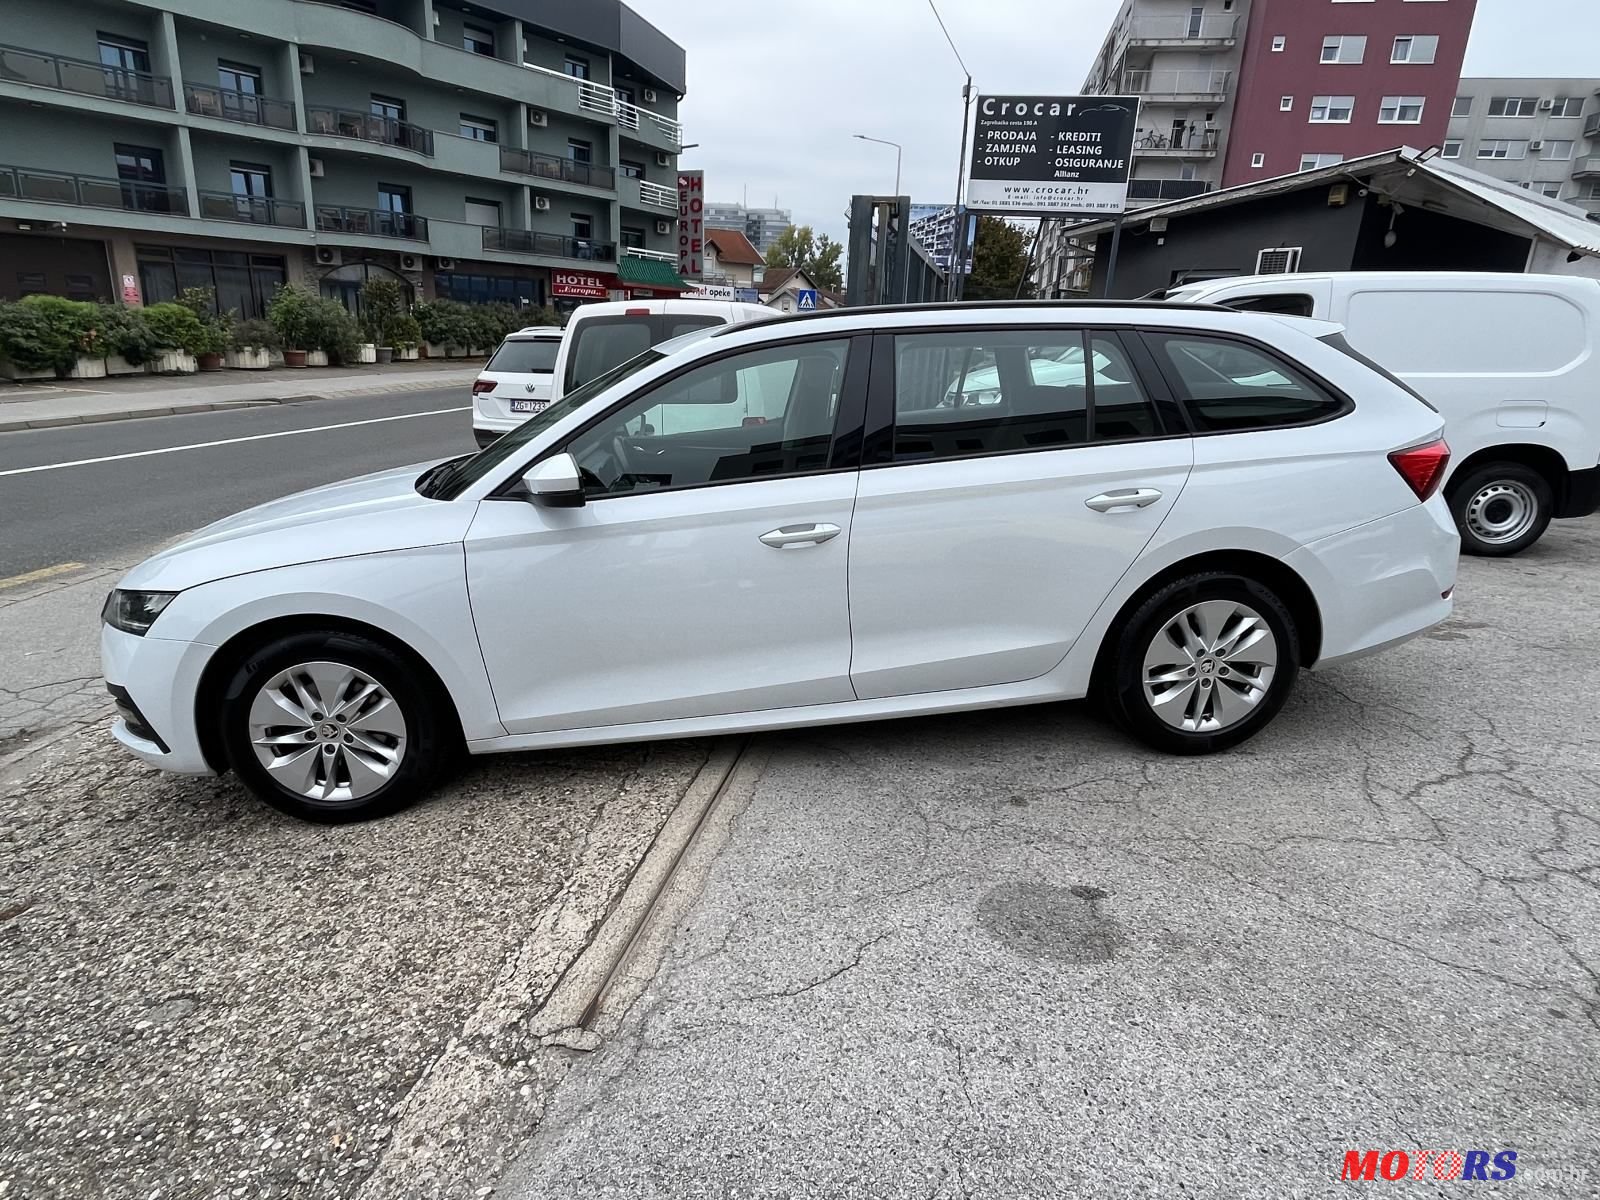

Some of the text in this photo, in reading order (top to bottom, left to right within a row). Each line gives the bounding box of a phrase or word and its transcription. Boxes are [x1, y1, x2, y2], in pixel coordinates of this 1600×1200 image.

[982, 98, 1077, 116] Crocar
[987, 130, 1037, 141] PRODAJA
[1058, 131, 1101, 142] KREDITI
[985, 143, 1037, 154] ZAMJENA
[1056, 145, 1103, 155] LEASING
[984, 156, 1021, 167] OTKUP
[1055, 158, 1124, 169] OSIGURANJE
[1054, 170, 1080, 178] Allianz
[1004, 186, 1089, 195] www.crocar.hr
[690, 176, 702, 274] HOTEL
[680, 191, 688, 275] EUROPA
[556, 275, 604, 287] HOTEL
[709, 288, 731, 298] opeke
